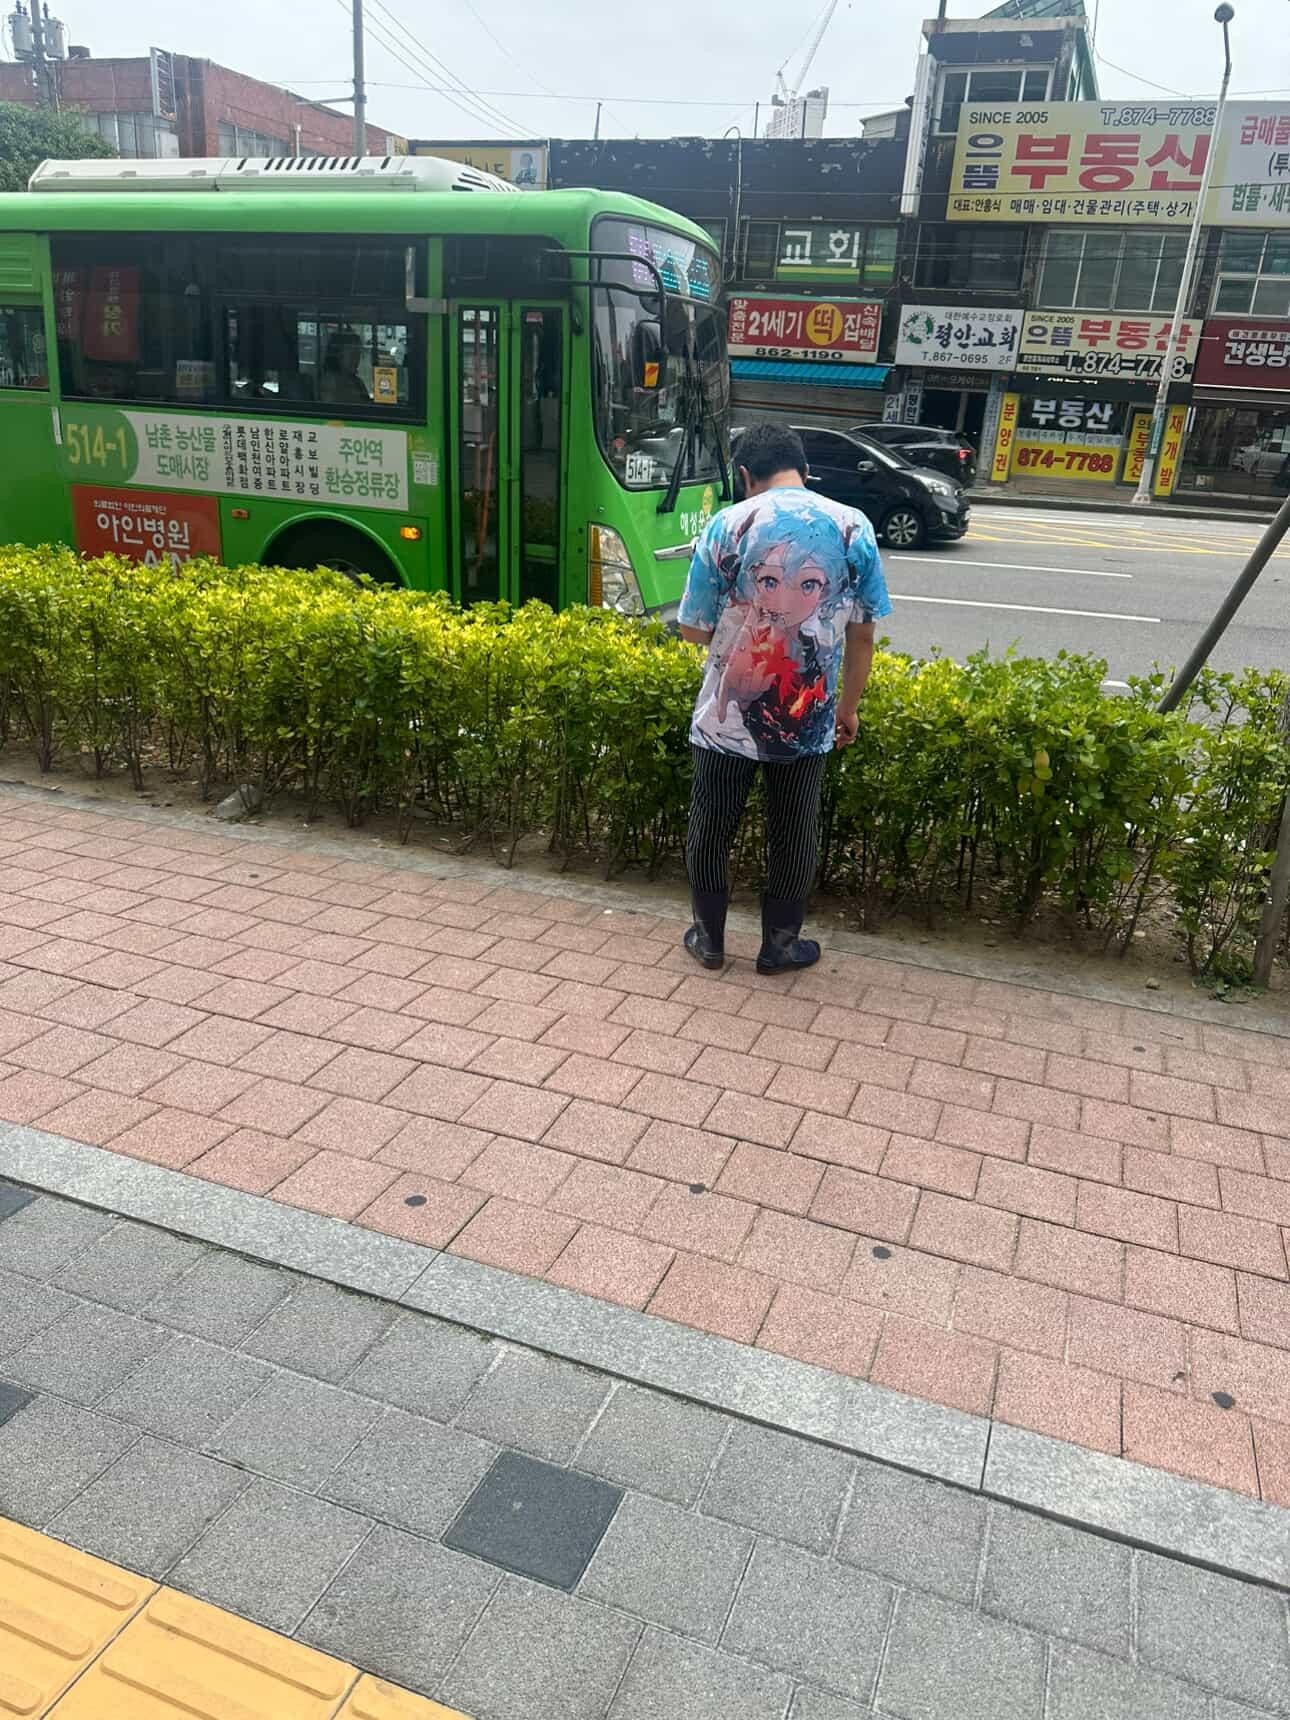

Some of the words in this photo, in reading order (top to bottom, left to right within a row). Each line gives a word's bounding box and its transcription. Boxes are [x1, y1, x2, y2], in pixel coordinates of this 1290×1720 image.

[969, 111, 1011, 124] SINCE
[1016, 111, 1048, 124] 2005
[1101, 107, 1216, 126] T.874-7788
[962, 133, 1004, 189] 으뜸
[1010, 133, 1212, 192] 부동산
[1268, 152, 1290, 176] (투
[780, 229, 860, 268] 교회
[748, 310, 803, 339] 21세기
[1031, 314, 1053, 323] SINCE
[1056, 315, 1075, 323] 2005
[1026, 325, 1073, 347] 으뜸
[1078, 319, 1193, 352] 부동산
[755, 347, 843, 359] 862-1190
[921, 351, 989, 364] T.867-0695
[998, 355, 1013, 365] 2F
[1032, 398, 1114, 430] 부동산
[66, 423, 128, 469] 514-1
[145, 424, 173, 449] 남촌
[176, 425, 217, 452] 농산물
[338, 437, 383, 467] 주안역
[1159, 415, 1184, 487] 재개발
[156, 454, 210, 481] 도매시장
[264, 427, 277, 490] 한신아파트
[307, 431, 320, 496] 교보빌딩
[1017, 448, 1114, 473] 874-7788
[325, 467, 399, 500] 환승정류장
[96, 513, 190, 550] 아인병원
